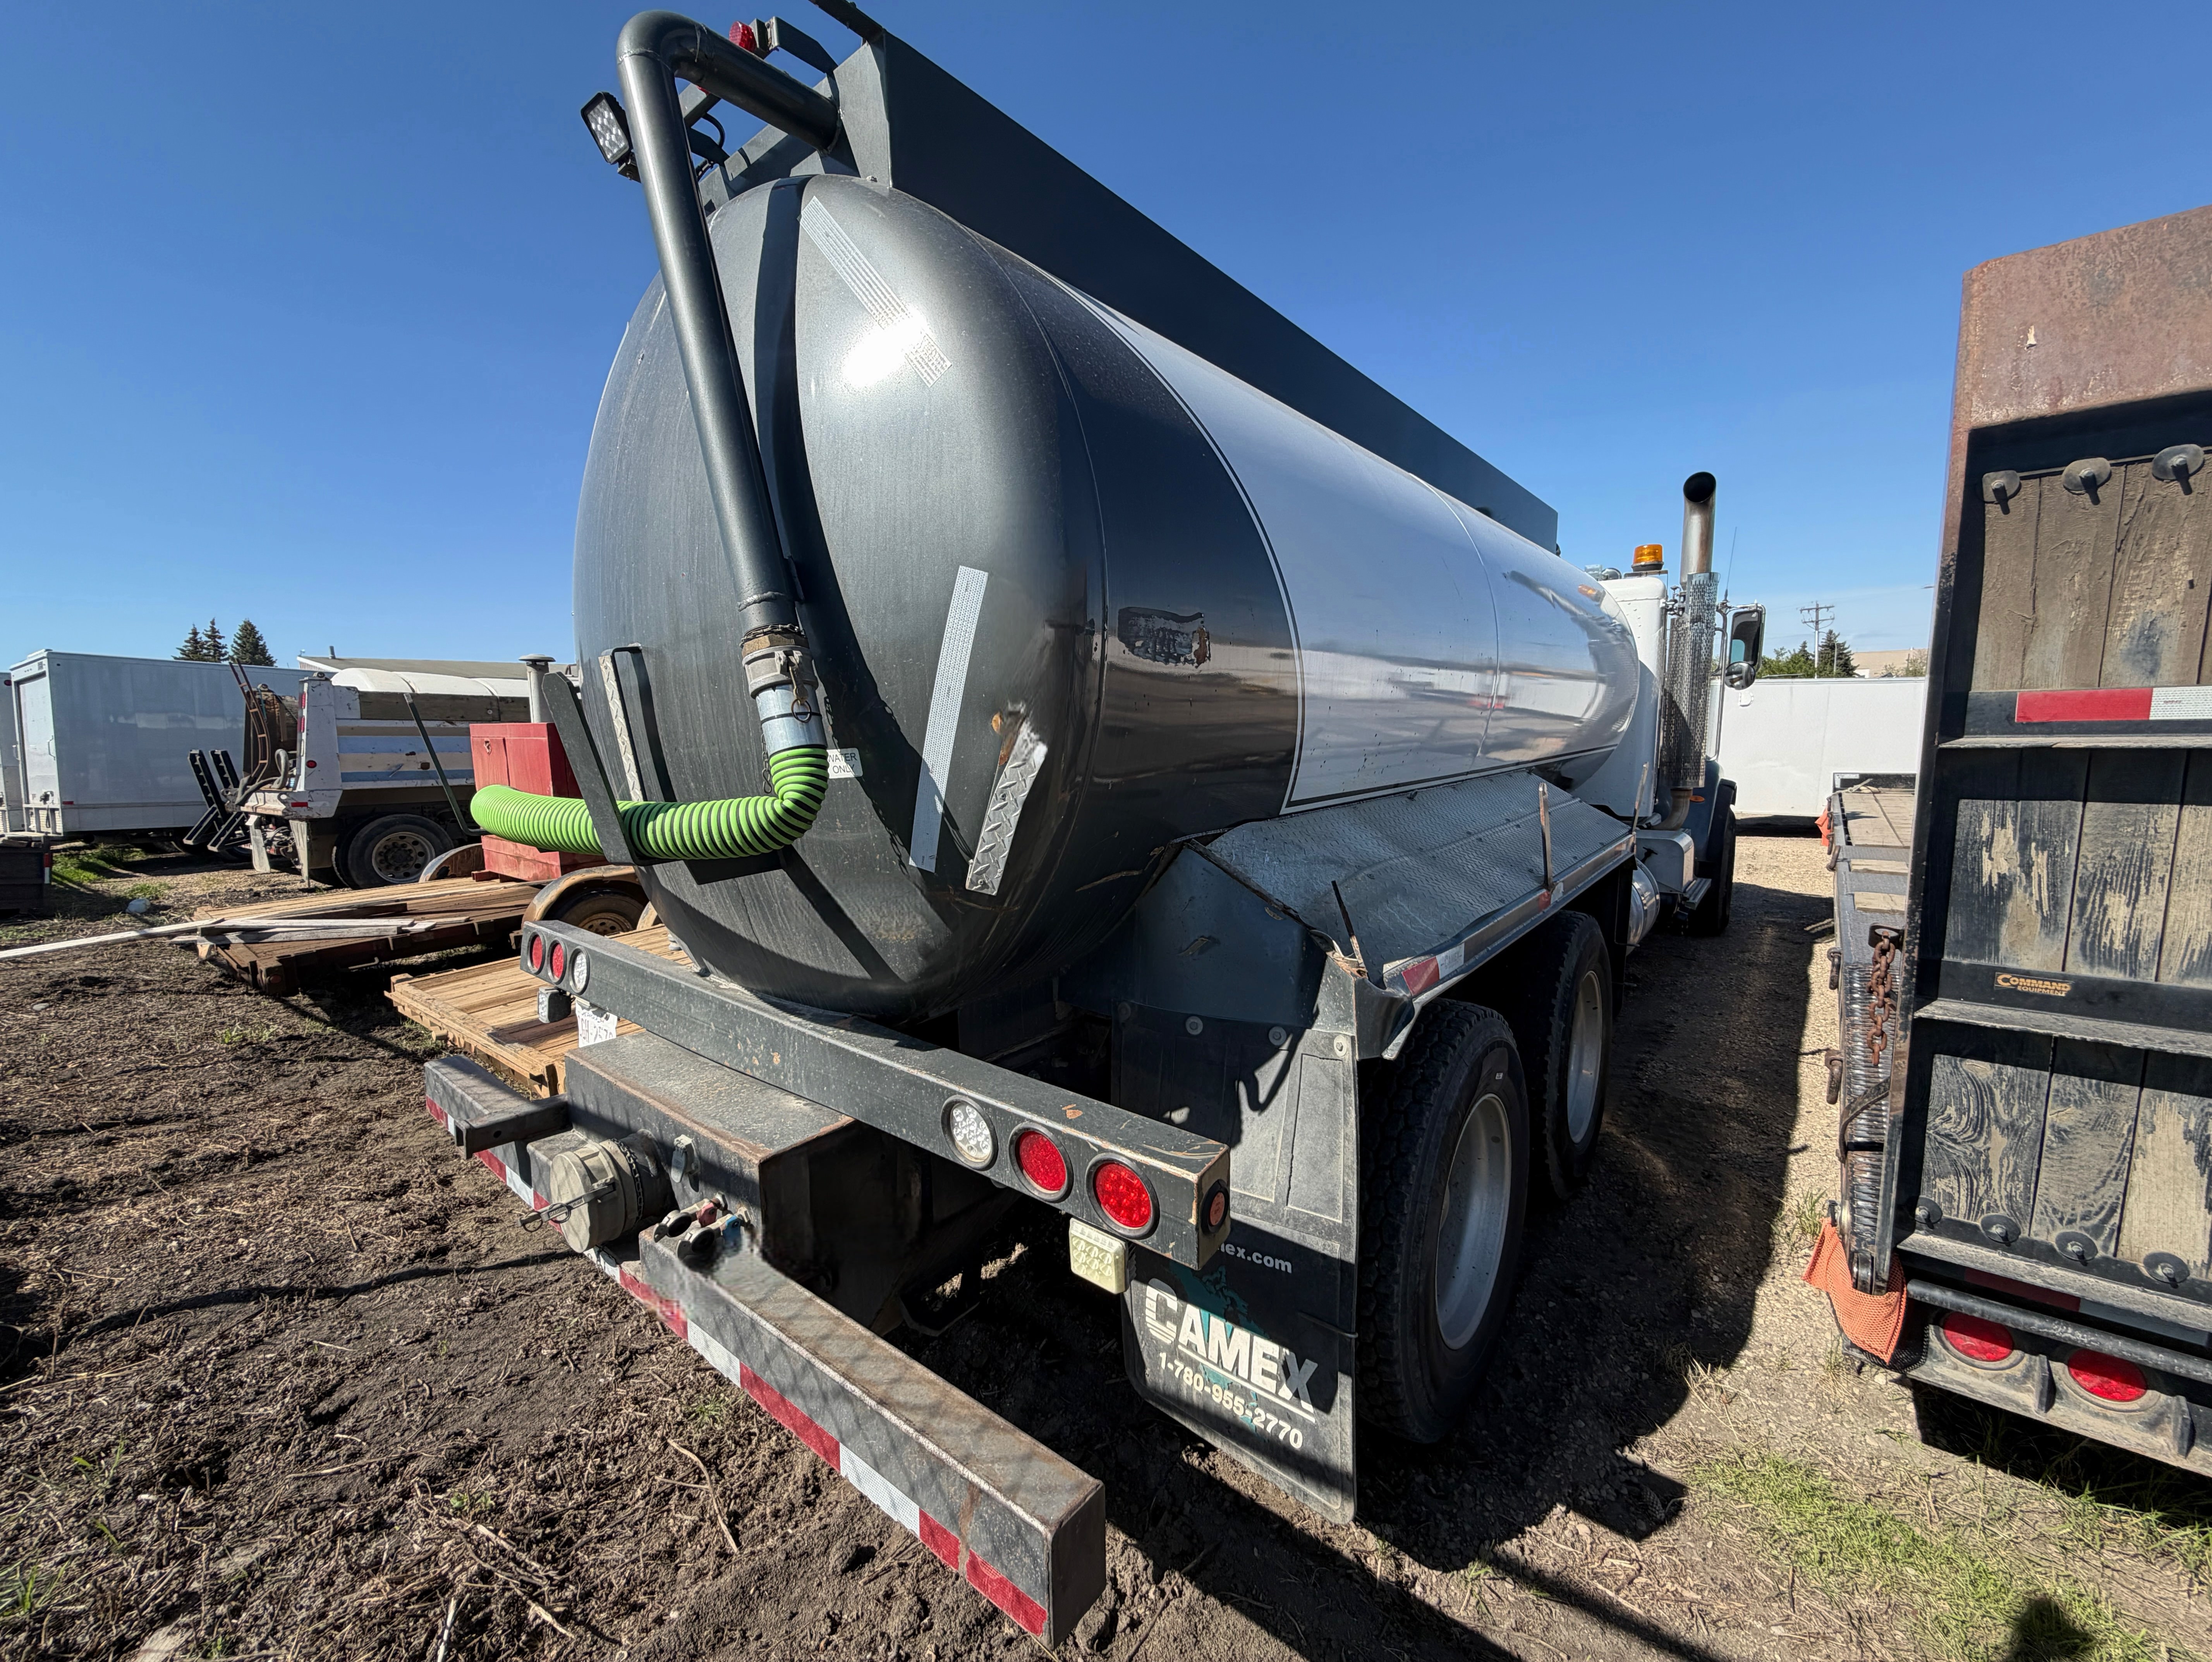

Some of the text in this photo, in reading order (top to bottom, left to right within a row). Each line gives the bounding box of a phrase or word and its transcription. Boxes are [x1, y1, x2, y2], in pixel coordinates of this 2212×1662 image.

[828, 752, 857, 762] WATER
[833, 764, 855, 774] ONLY
[1997, 974, 2071, 991] COMMAND
[2017, 986, 2067, 996] EQUIPMENT
[1145, 1277, 1318, 1413] CAMEX
[1159, 1352, 1304, 1449] 1-780-955-2770
